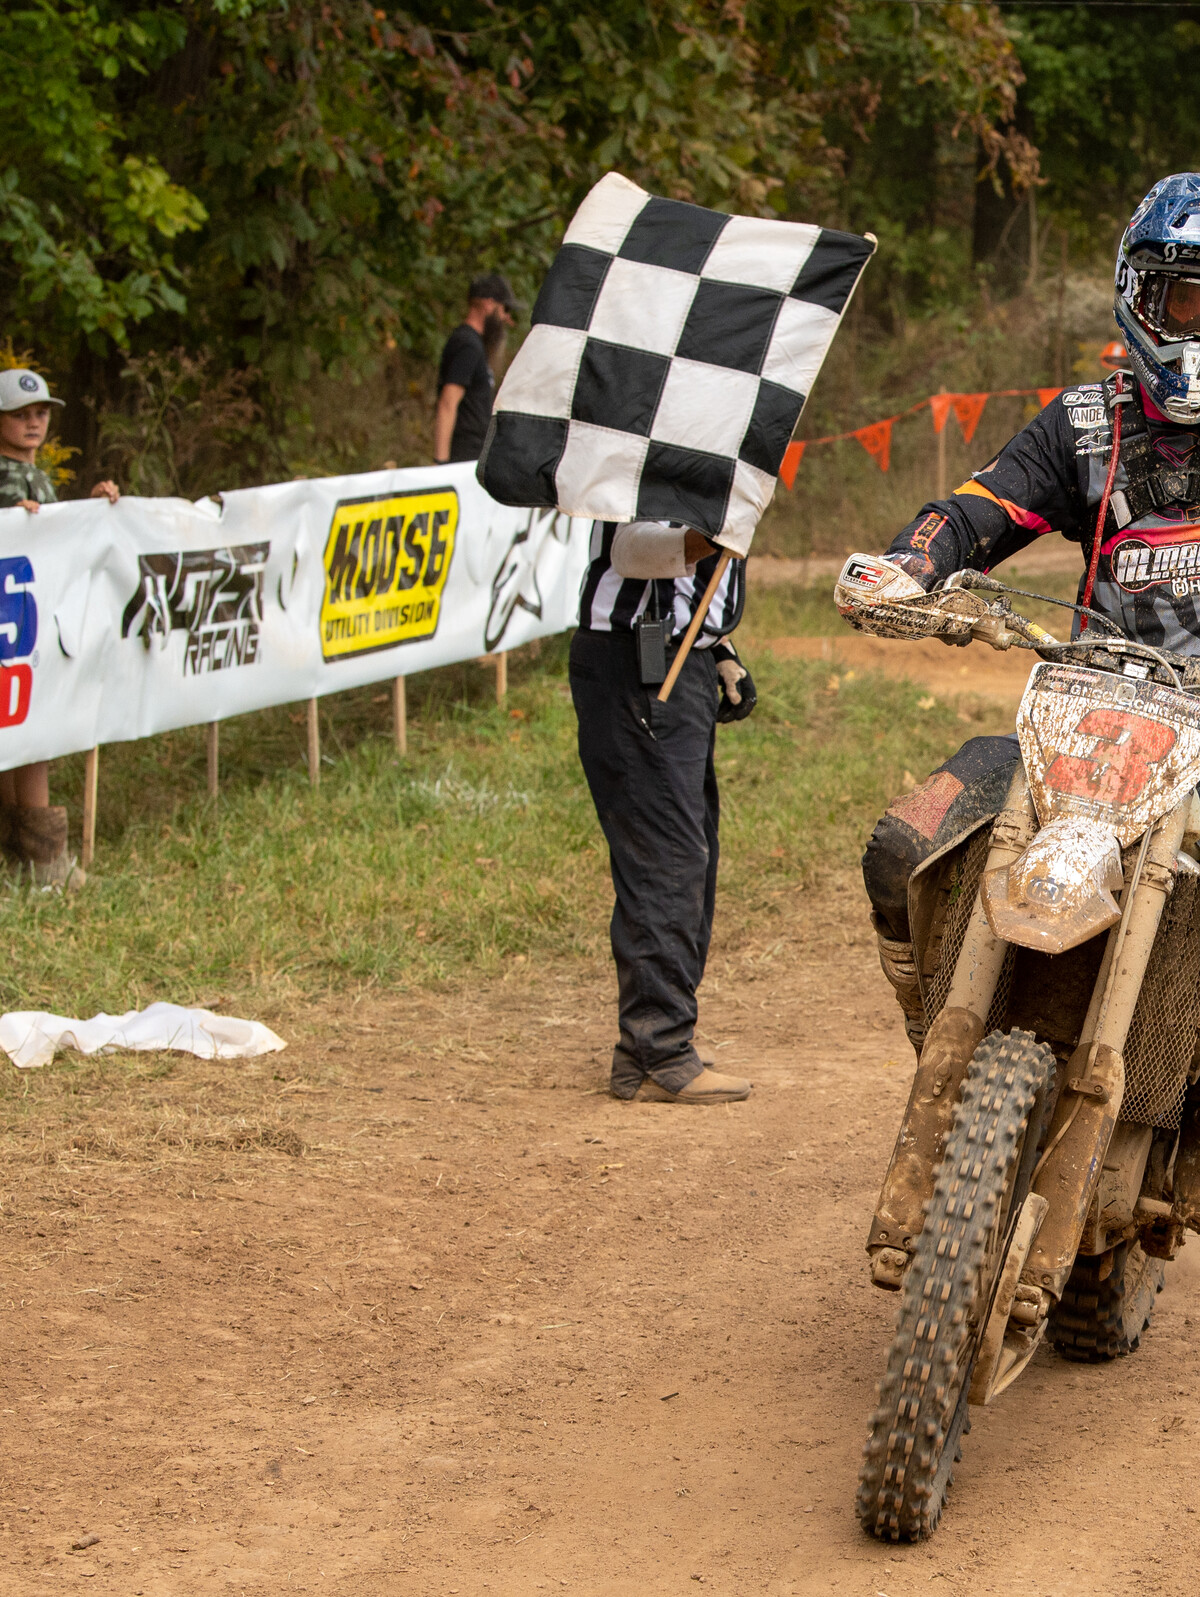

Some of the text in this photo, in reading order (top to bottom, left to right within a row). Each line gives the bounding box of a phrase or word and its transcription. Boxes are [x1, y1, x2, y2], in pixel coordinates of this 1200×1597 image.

[328, 510, 450, 605] MOOSE
[847, 562, 884, 584] G2
[325, 599, 436, 643] UTILITY DIVISION
[1045, 708, 1178, 807] 3
